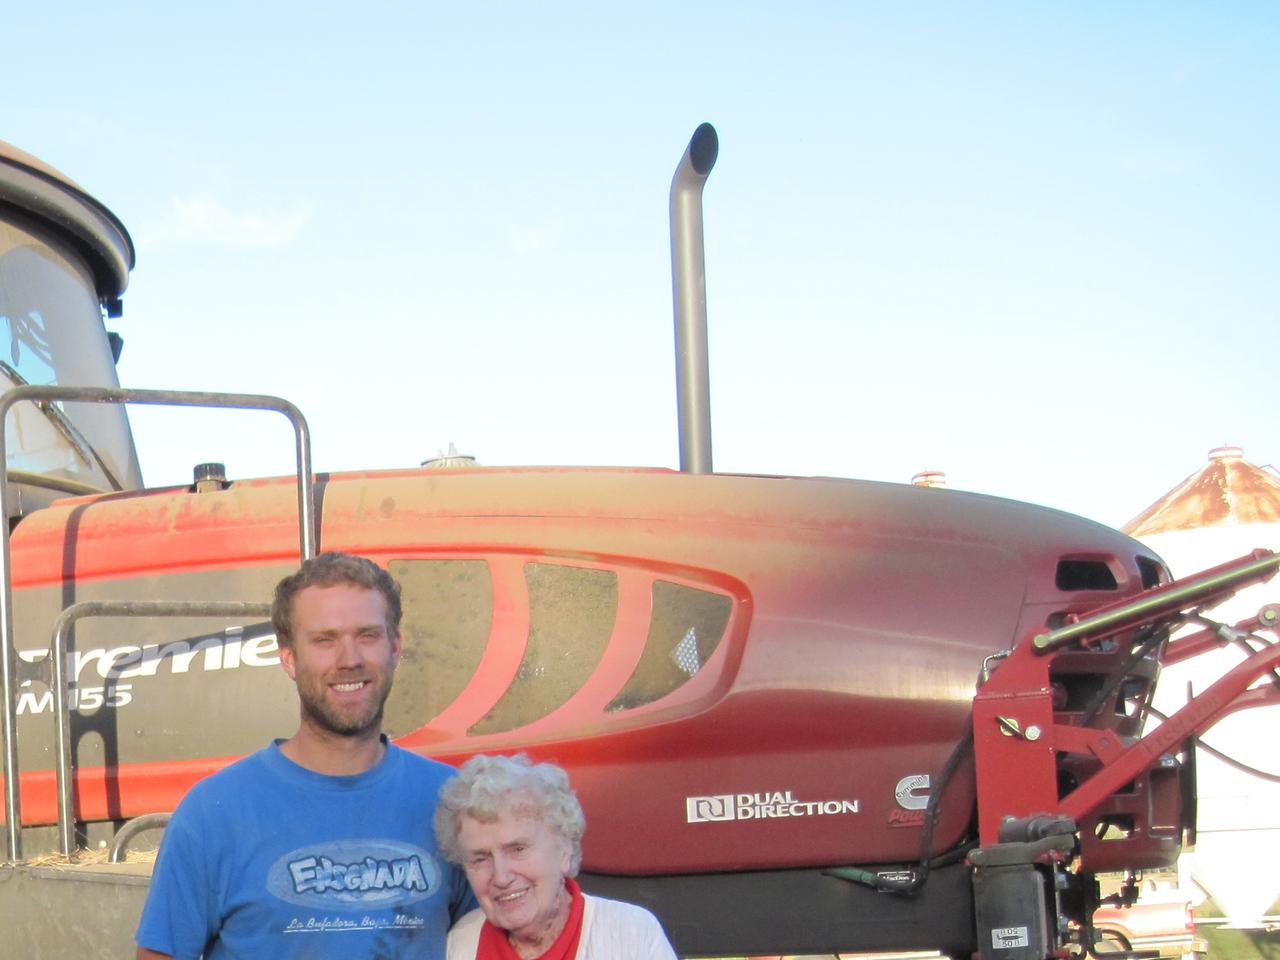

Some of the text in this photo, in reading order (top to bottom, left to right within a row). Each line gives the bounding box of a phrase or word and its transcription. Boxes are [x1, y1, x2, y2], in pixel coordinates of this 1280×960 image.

[18, 626, 281, 687] remie
[737, 791, 799, 807] DUAL
[737, 800, 859, 820] DIRECTION
